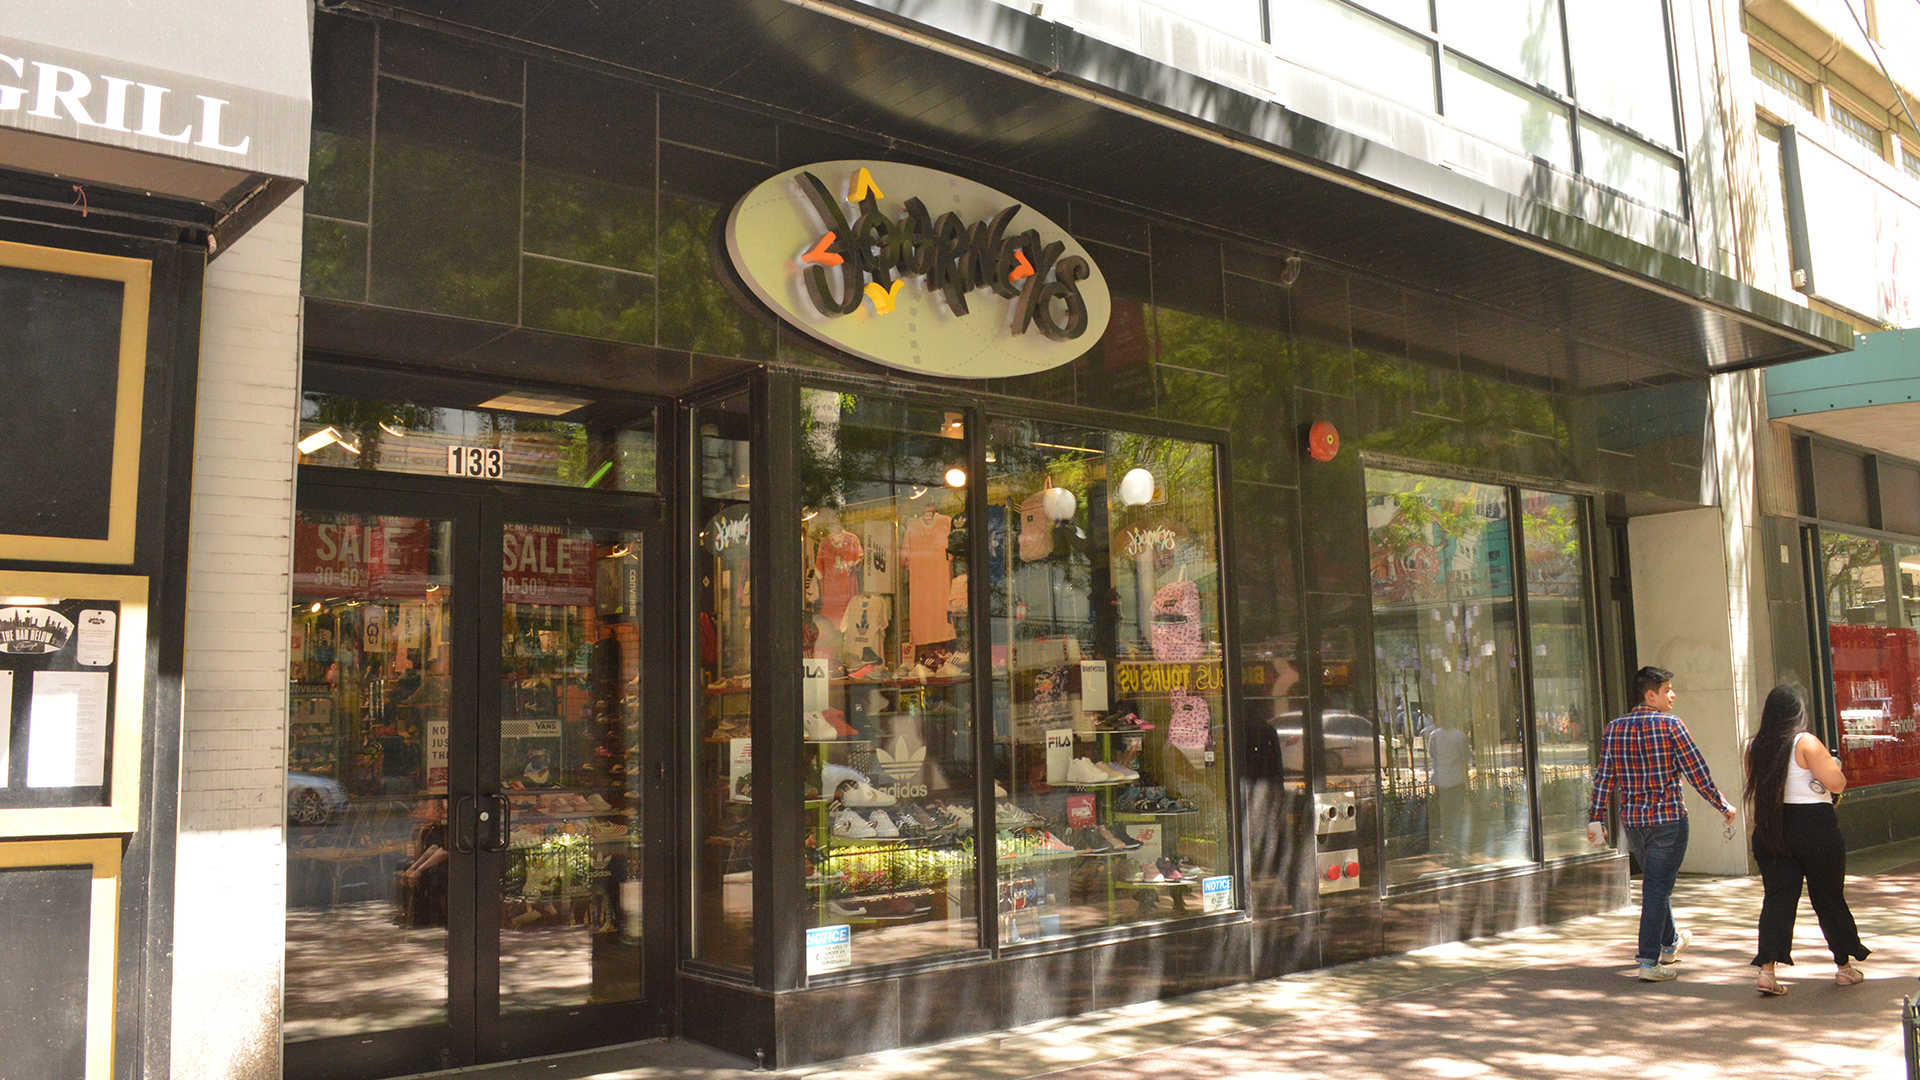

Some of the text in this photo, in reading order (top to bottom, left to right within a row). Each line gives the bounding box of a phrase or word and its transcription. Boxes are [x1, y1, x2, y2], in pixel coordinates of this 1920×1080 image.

[453, 447, 501, 477] 133
[503, 524, 564, 534] SEMI-ANNU
[316, 524, 401, 565] SALE
[502, 534, 573, 574] SALE
[432, 726, 449, 735] NO
[1894, 715, 1916, 737] photo
[1048, 735, 1071, 748] FILA
[1205, 879, 1232, 892] NOTICE
[806, 929, 848, 946] NOTICE
